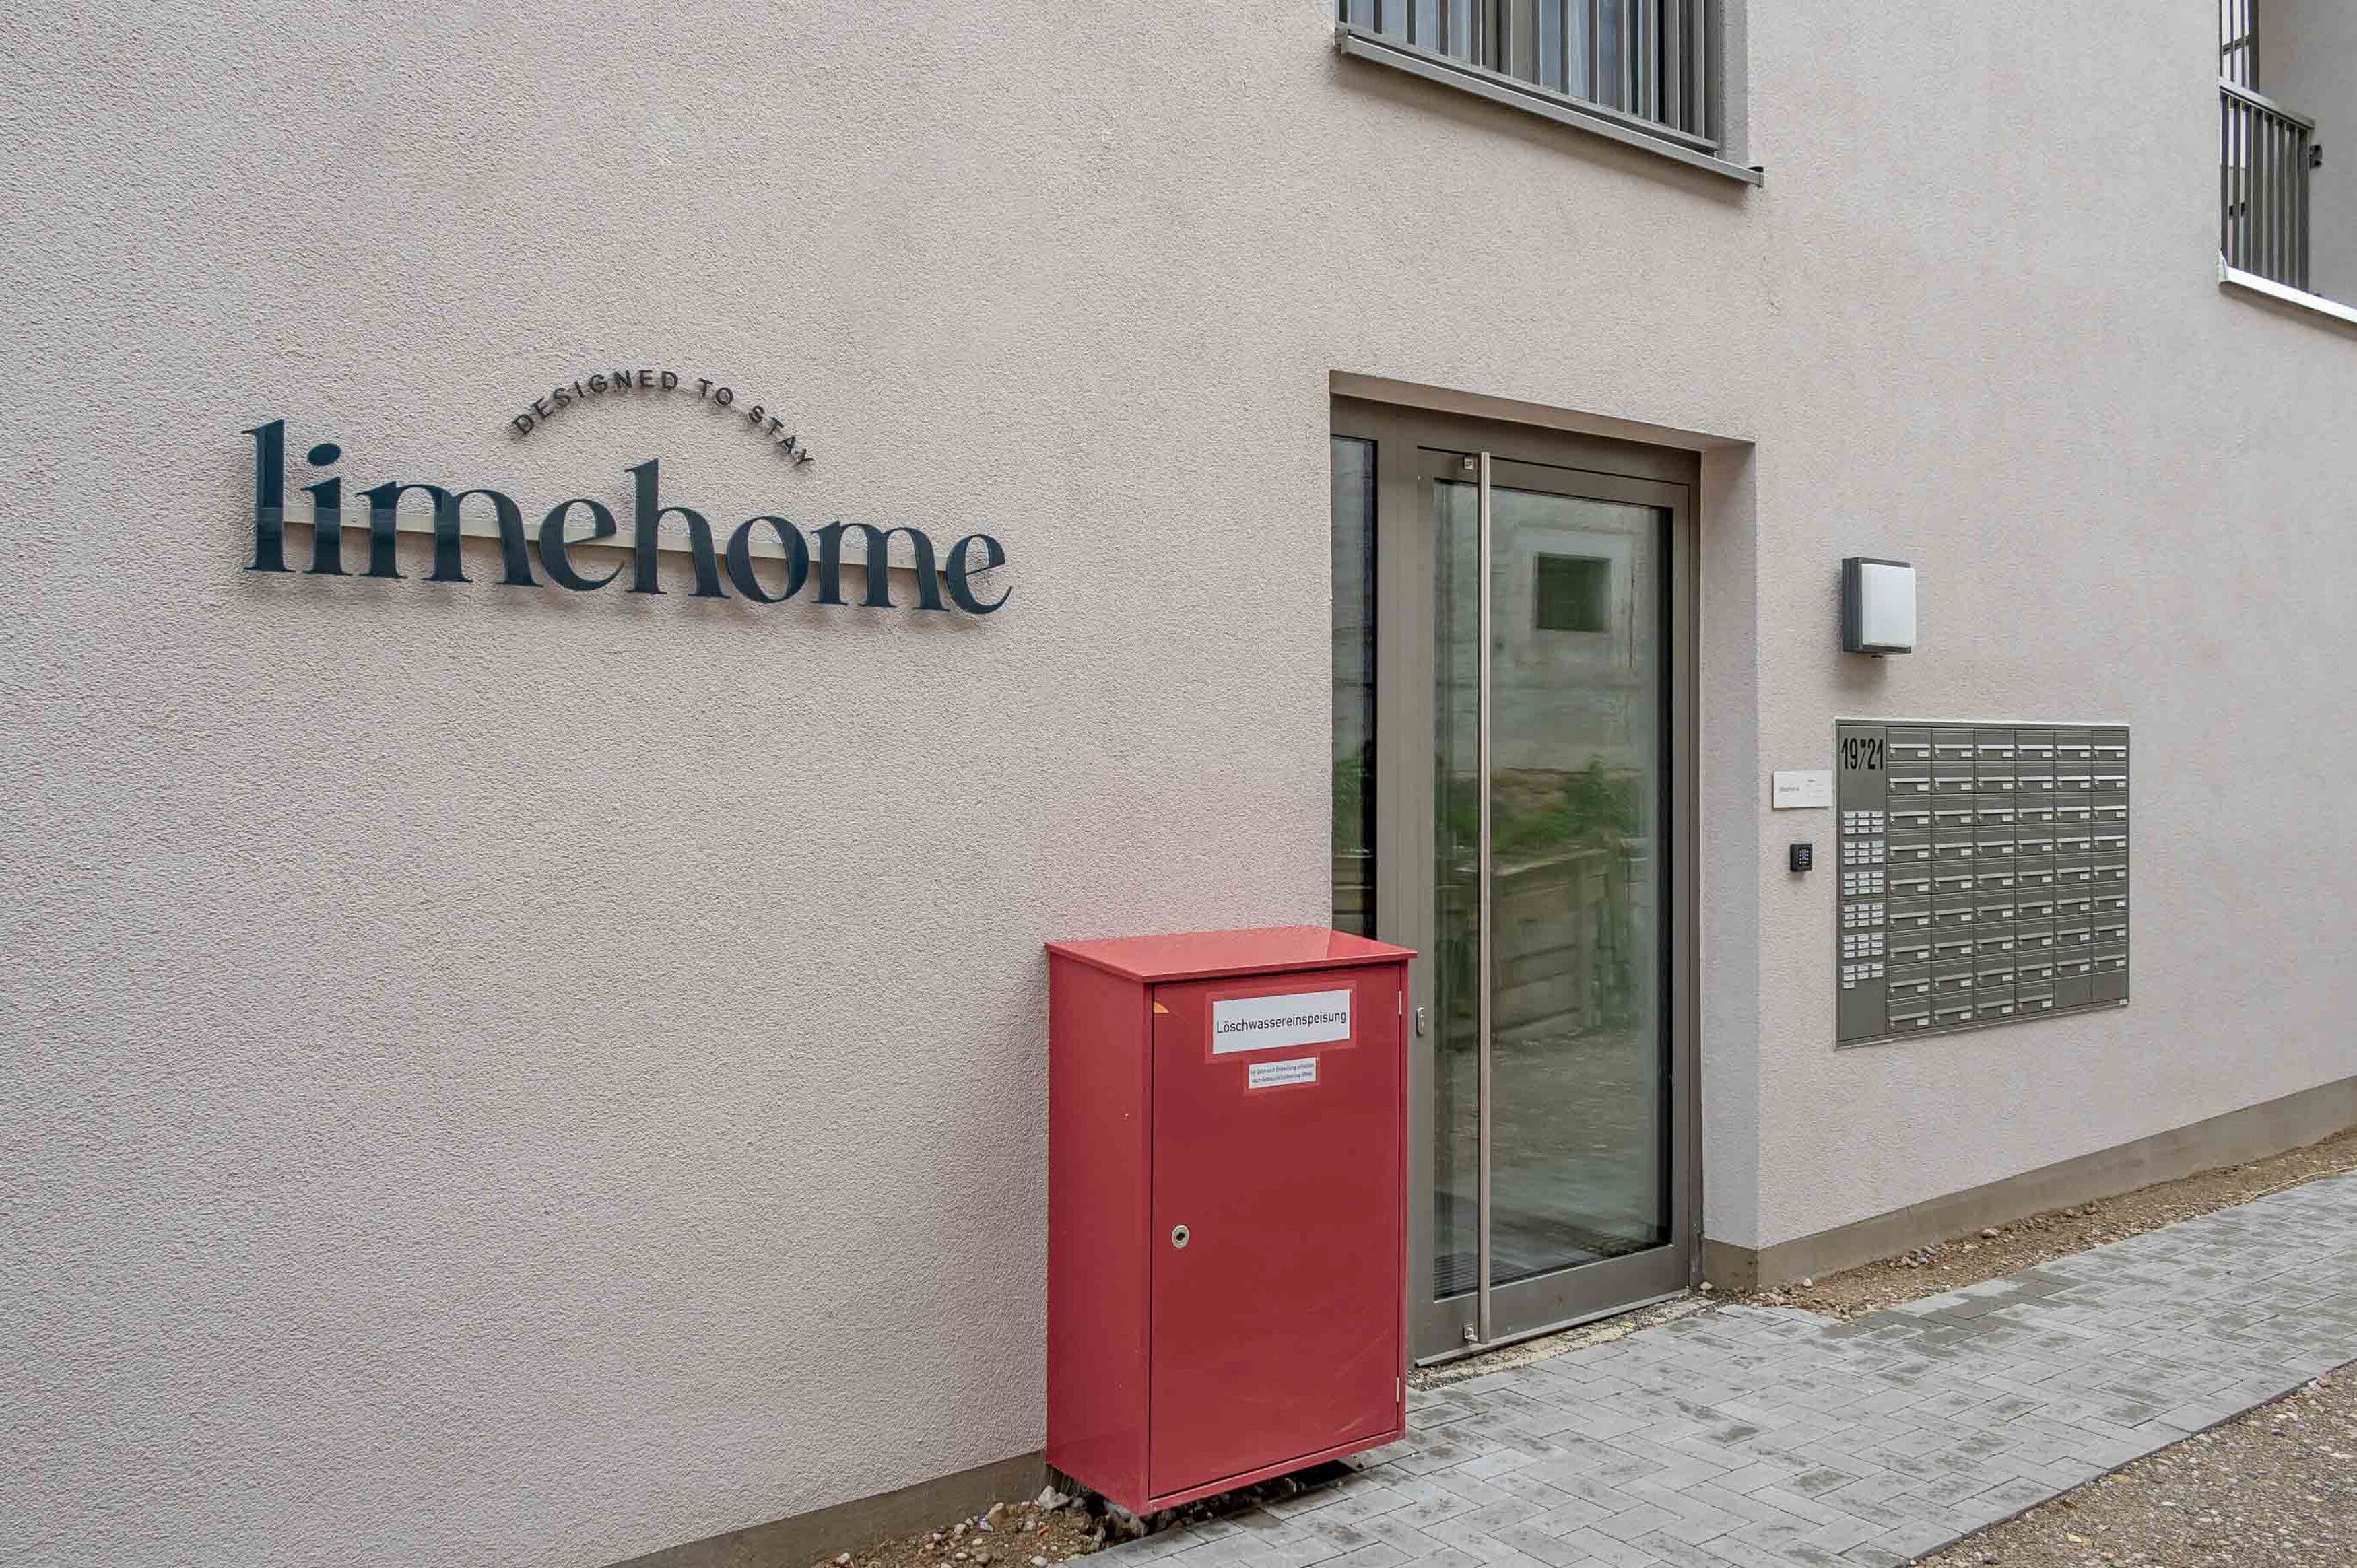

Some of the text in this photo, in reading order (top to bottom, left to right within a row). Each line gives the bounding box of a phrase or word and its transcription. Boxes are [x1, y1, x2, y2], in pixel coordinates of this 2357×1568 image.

[512, 369, 813, 466] DESIGNED TO STAY
[243, 419, 1012, 614] limehome
[1217, 1011, 1346, 1033] Löschwassereinspeisung
